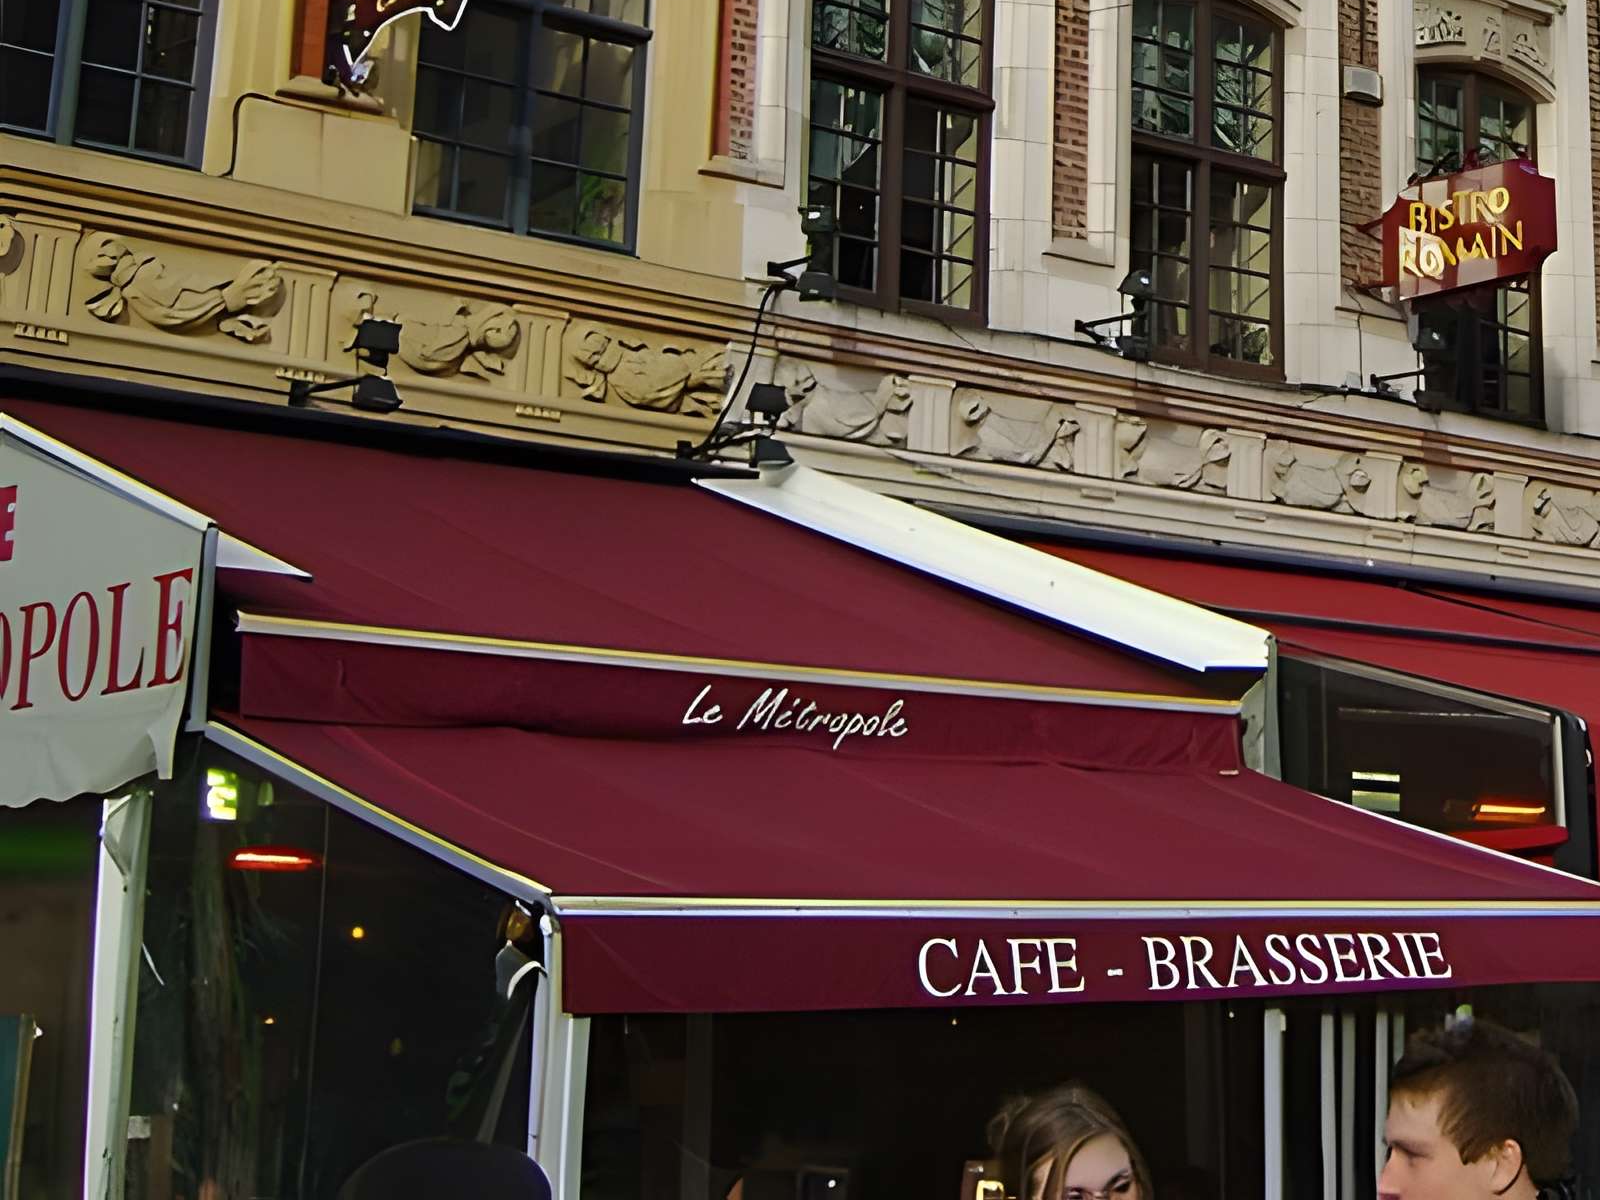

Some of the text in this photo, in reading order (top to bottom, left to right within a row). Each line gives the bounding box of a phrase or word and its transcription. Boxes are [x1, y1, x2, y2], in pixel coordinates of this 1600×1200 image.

[1409, 186, 1510, 234] BISTRO
[1402, 220, 1523, 280] ROMAIN
[683, 684, 909, 750] Le Métropole
[918, 937, 1085, 997] CAFE
[1141, 931, 1453, 991] BRASSERIE
